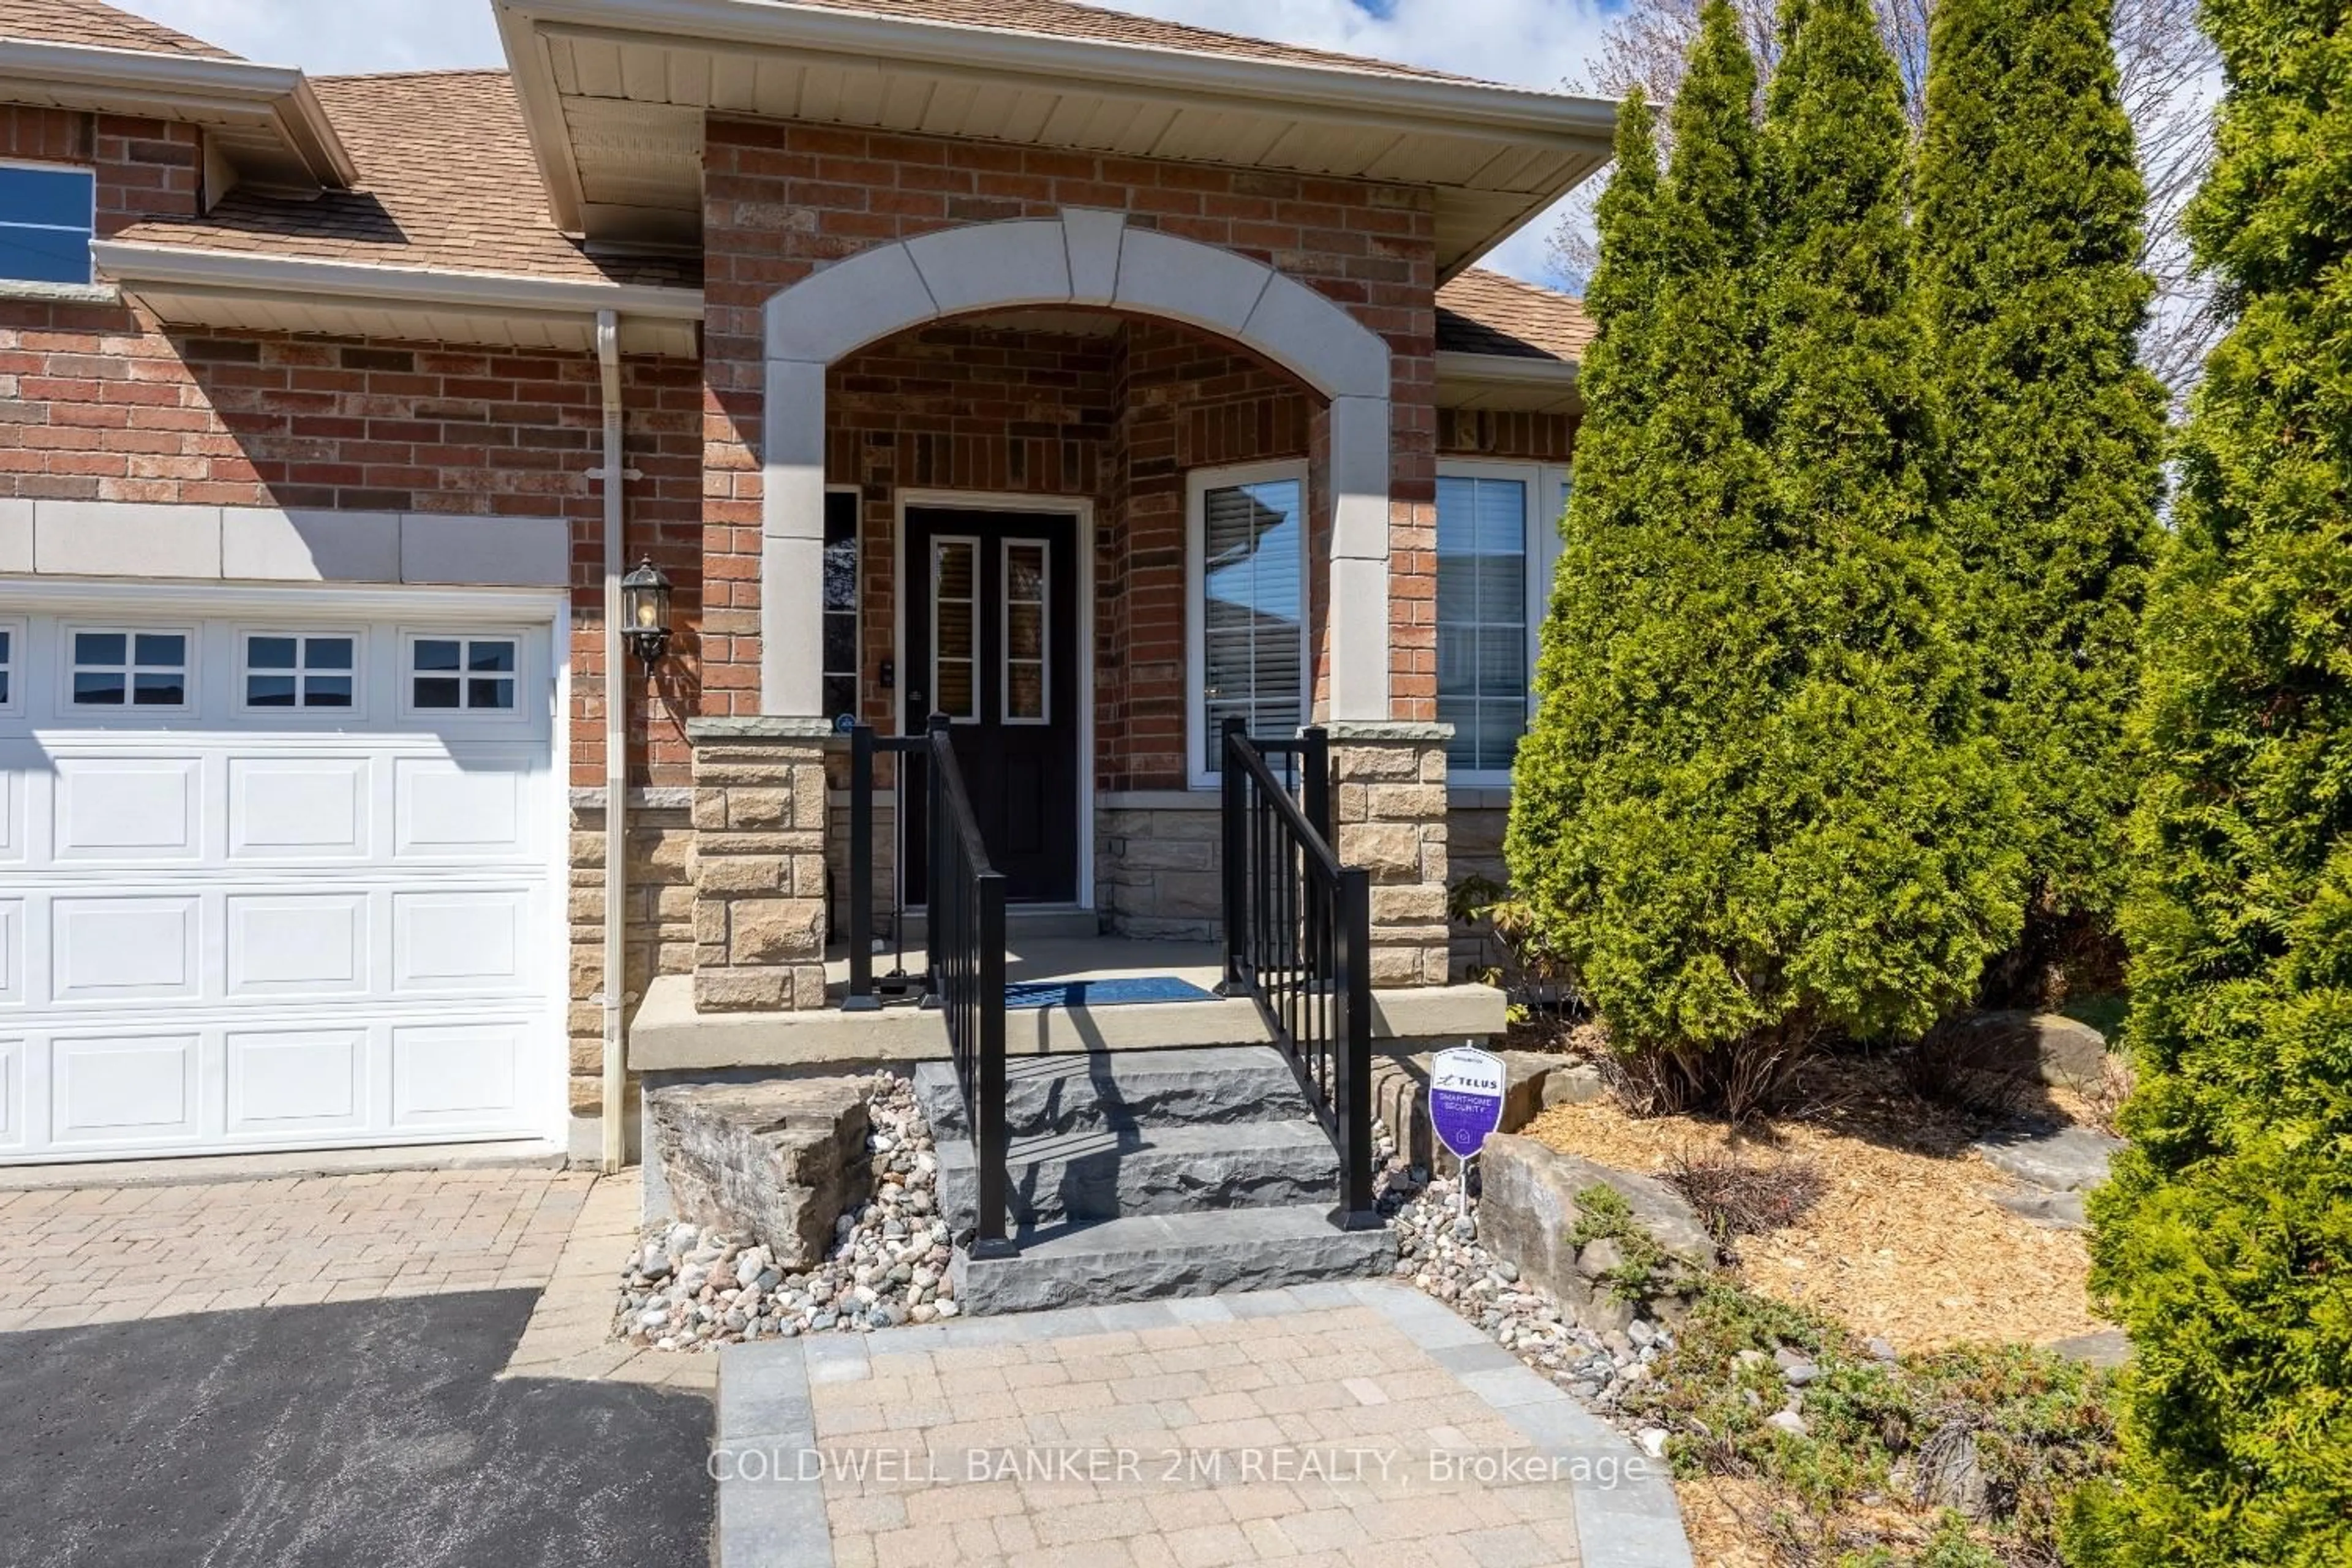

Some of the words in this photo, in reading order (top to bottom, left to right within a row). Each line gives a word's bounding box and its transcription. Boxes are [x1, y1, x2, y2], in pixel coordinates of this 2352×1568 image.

[1458, 1077, 1498, 1089] TELUS
[1439, 1093, 1492, 1106] SMARTHOME
[1444, 1102, 1485, 1113] SECURITY
